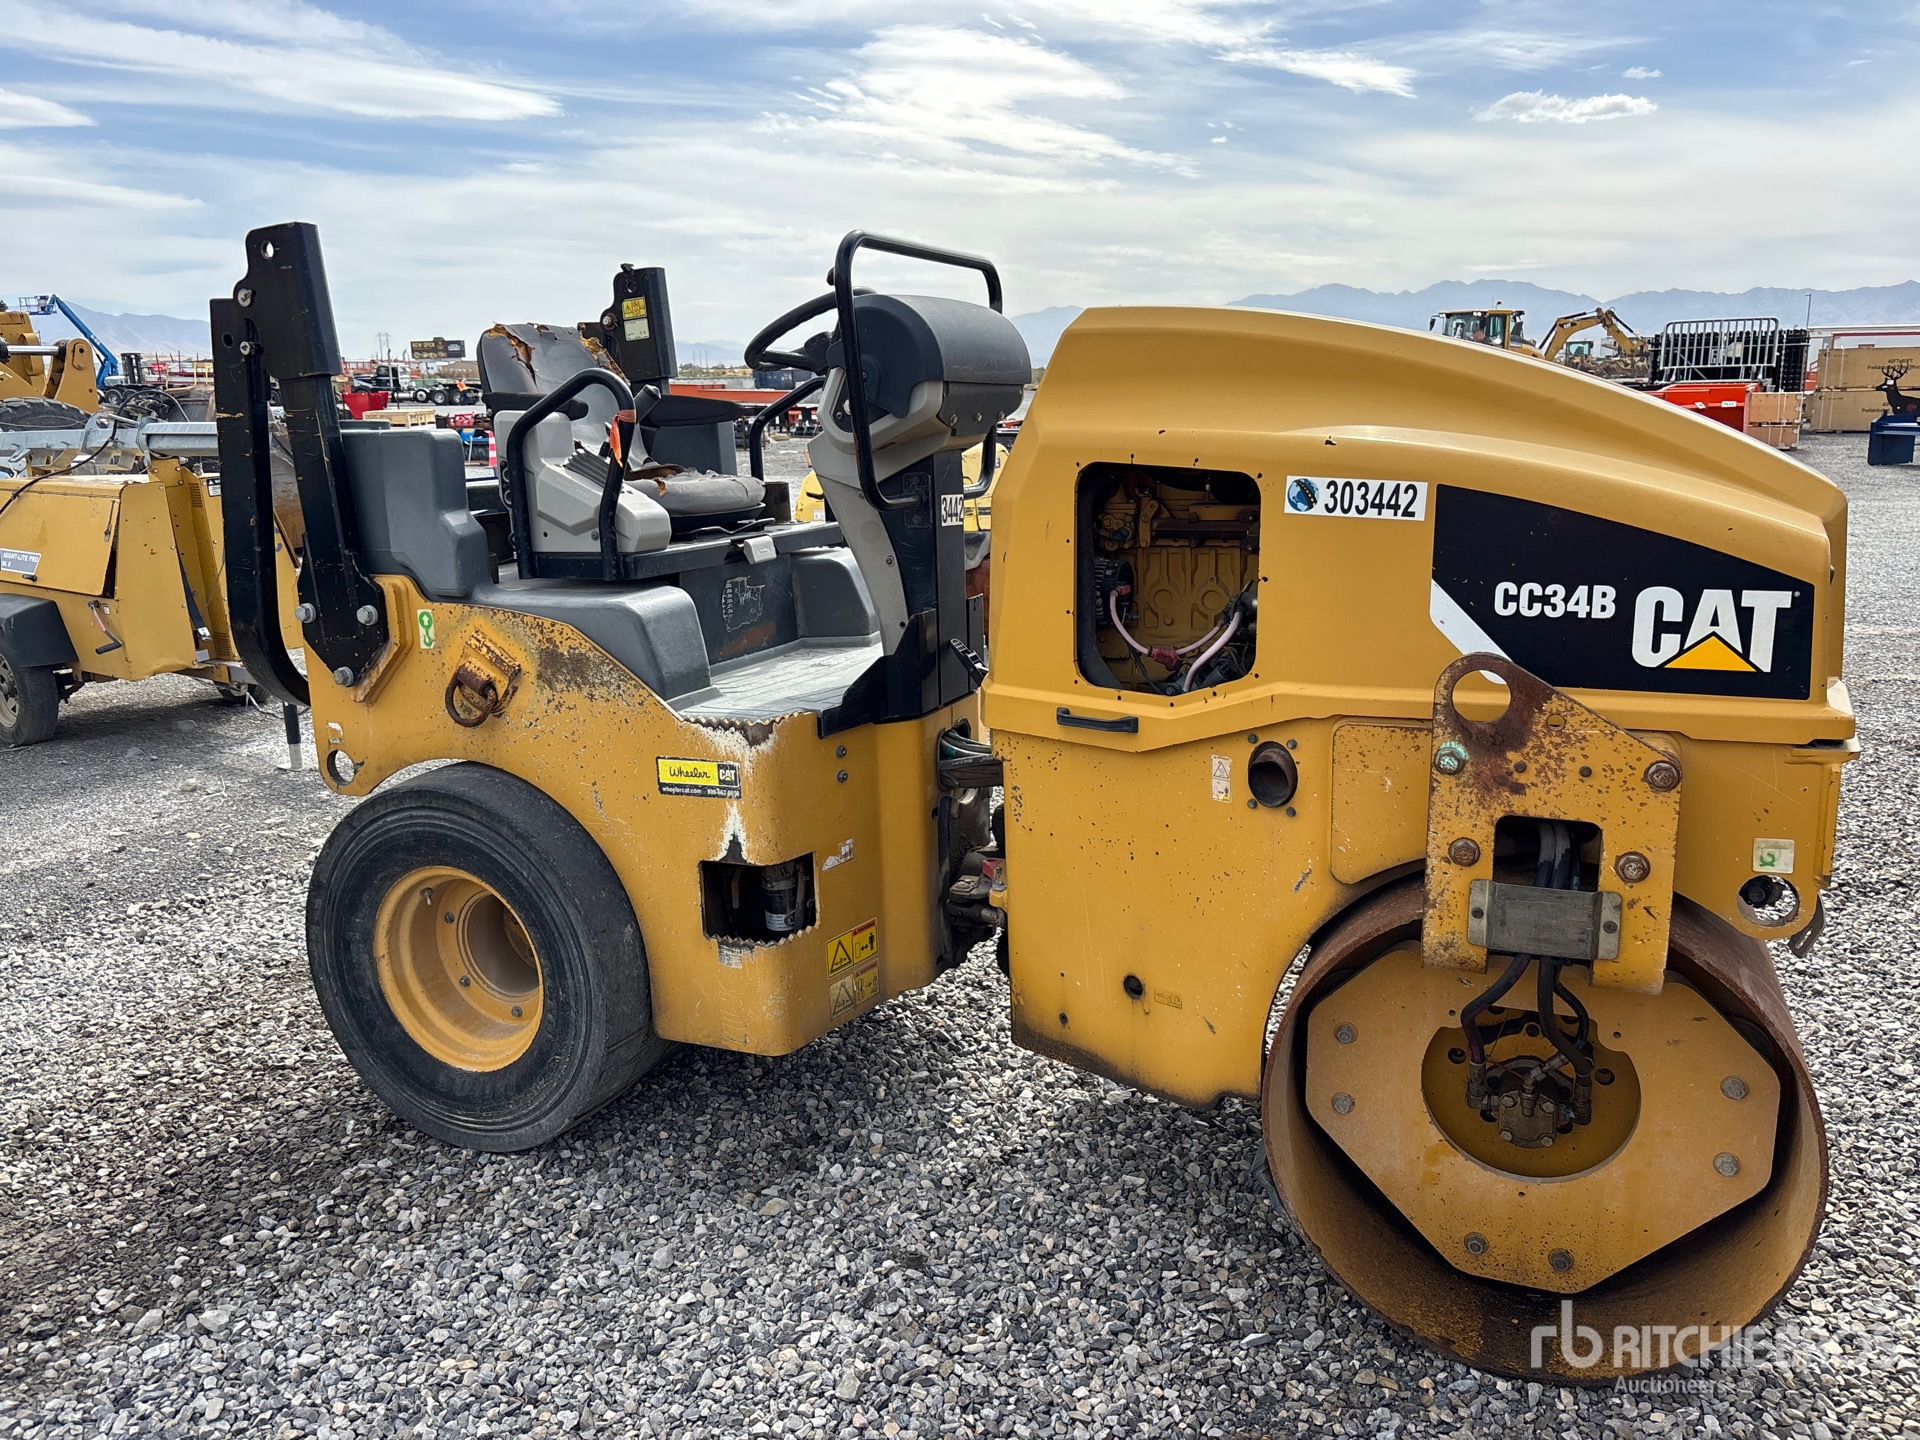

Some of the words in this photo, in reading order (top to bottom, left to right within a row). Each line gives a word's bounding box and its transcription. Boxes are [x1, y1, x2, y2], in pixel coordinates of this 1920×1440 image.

[942, 496, 964, 523] 3442
[1324, 479, 1418, 518] 303442
[1494, 581, 1617, 620] CC34B
[1631, 585, 1793, 673] CAT
[669, 766, 711, 779] Wheeler
[719, 769, 736, 781] CAT
